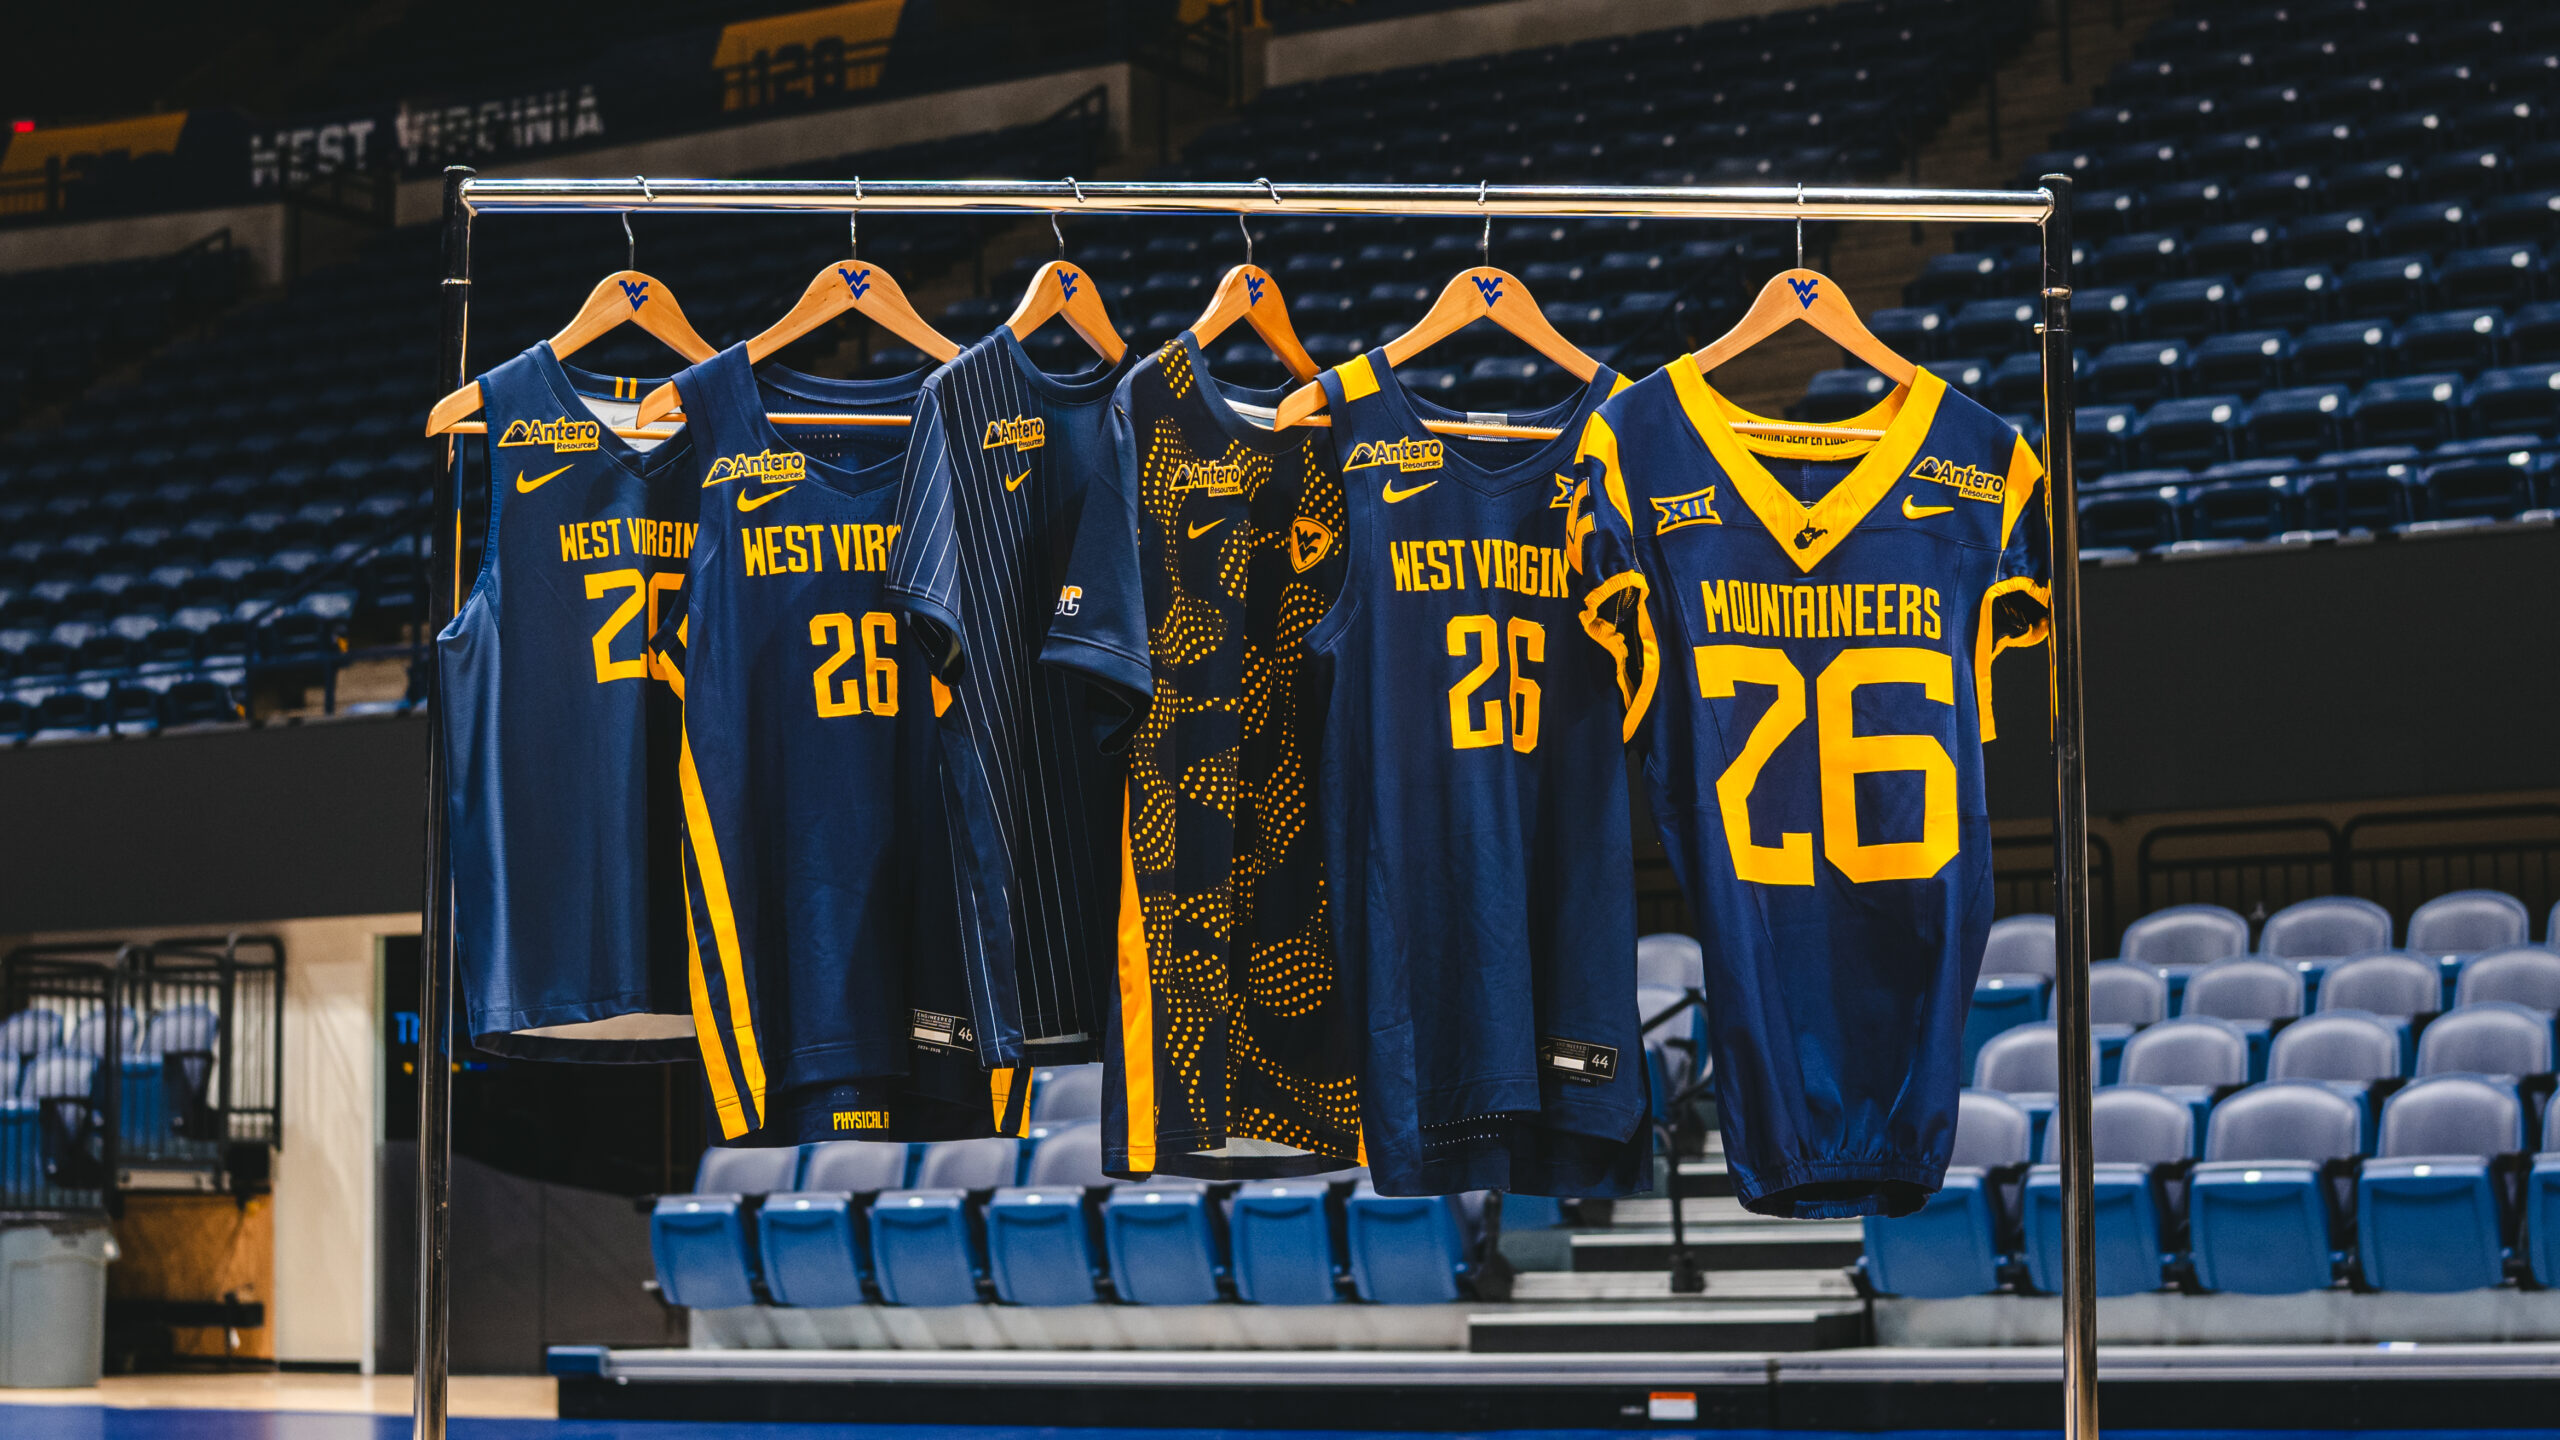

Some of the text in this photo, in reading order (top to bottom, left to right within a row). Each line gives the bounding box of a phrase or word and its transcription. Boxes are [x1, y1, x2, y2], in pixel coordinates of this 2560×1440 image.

[528, 421, 597, 442] Antero
[1001, 420, 1043, 442] Antero
[556, 441, 596, 450] Resources
[1375, 441, 1441, 463] Antero
[734, 454, 803, 476] Antero
[1402, 459, 1441, 470] Resources
[763, 471, 803, 482] Resources
[1191, 467, 1240, 487] Antero
[1938, 463, 2004, 492] Antero
[1210, 485, 1239, 495] Resources
[1961, 487, 2000, 501] Resources
[559, 518, 622, 562] WEST
[741, 524, 825, 577] WEST
[1390, 539, 1466, 592] WEST
[1700, 578, 1941, 640] MOUNTAINEERS
[809, 611, 900, 718] 26
[1446, 614, 1546, 754] 26
[1693, 644, 1960, 887] 26
[958, 1026, 973, 1042] 46
[1591, 1053, 1609, 1069] 44
[833, 1111, 883, 1130] PHYSICAL
